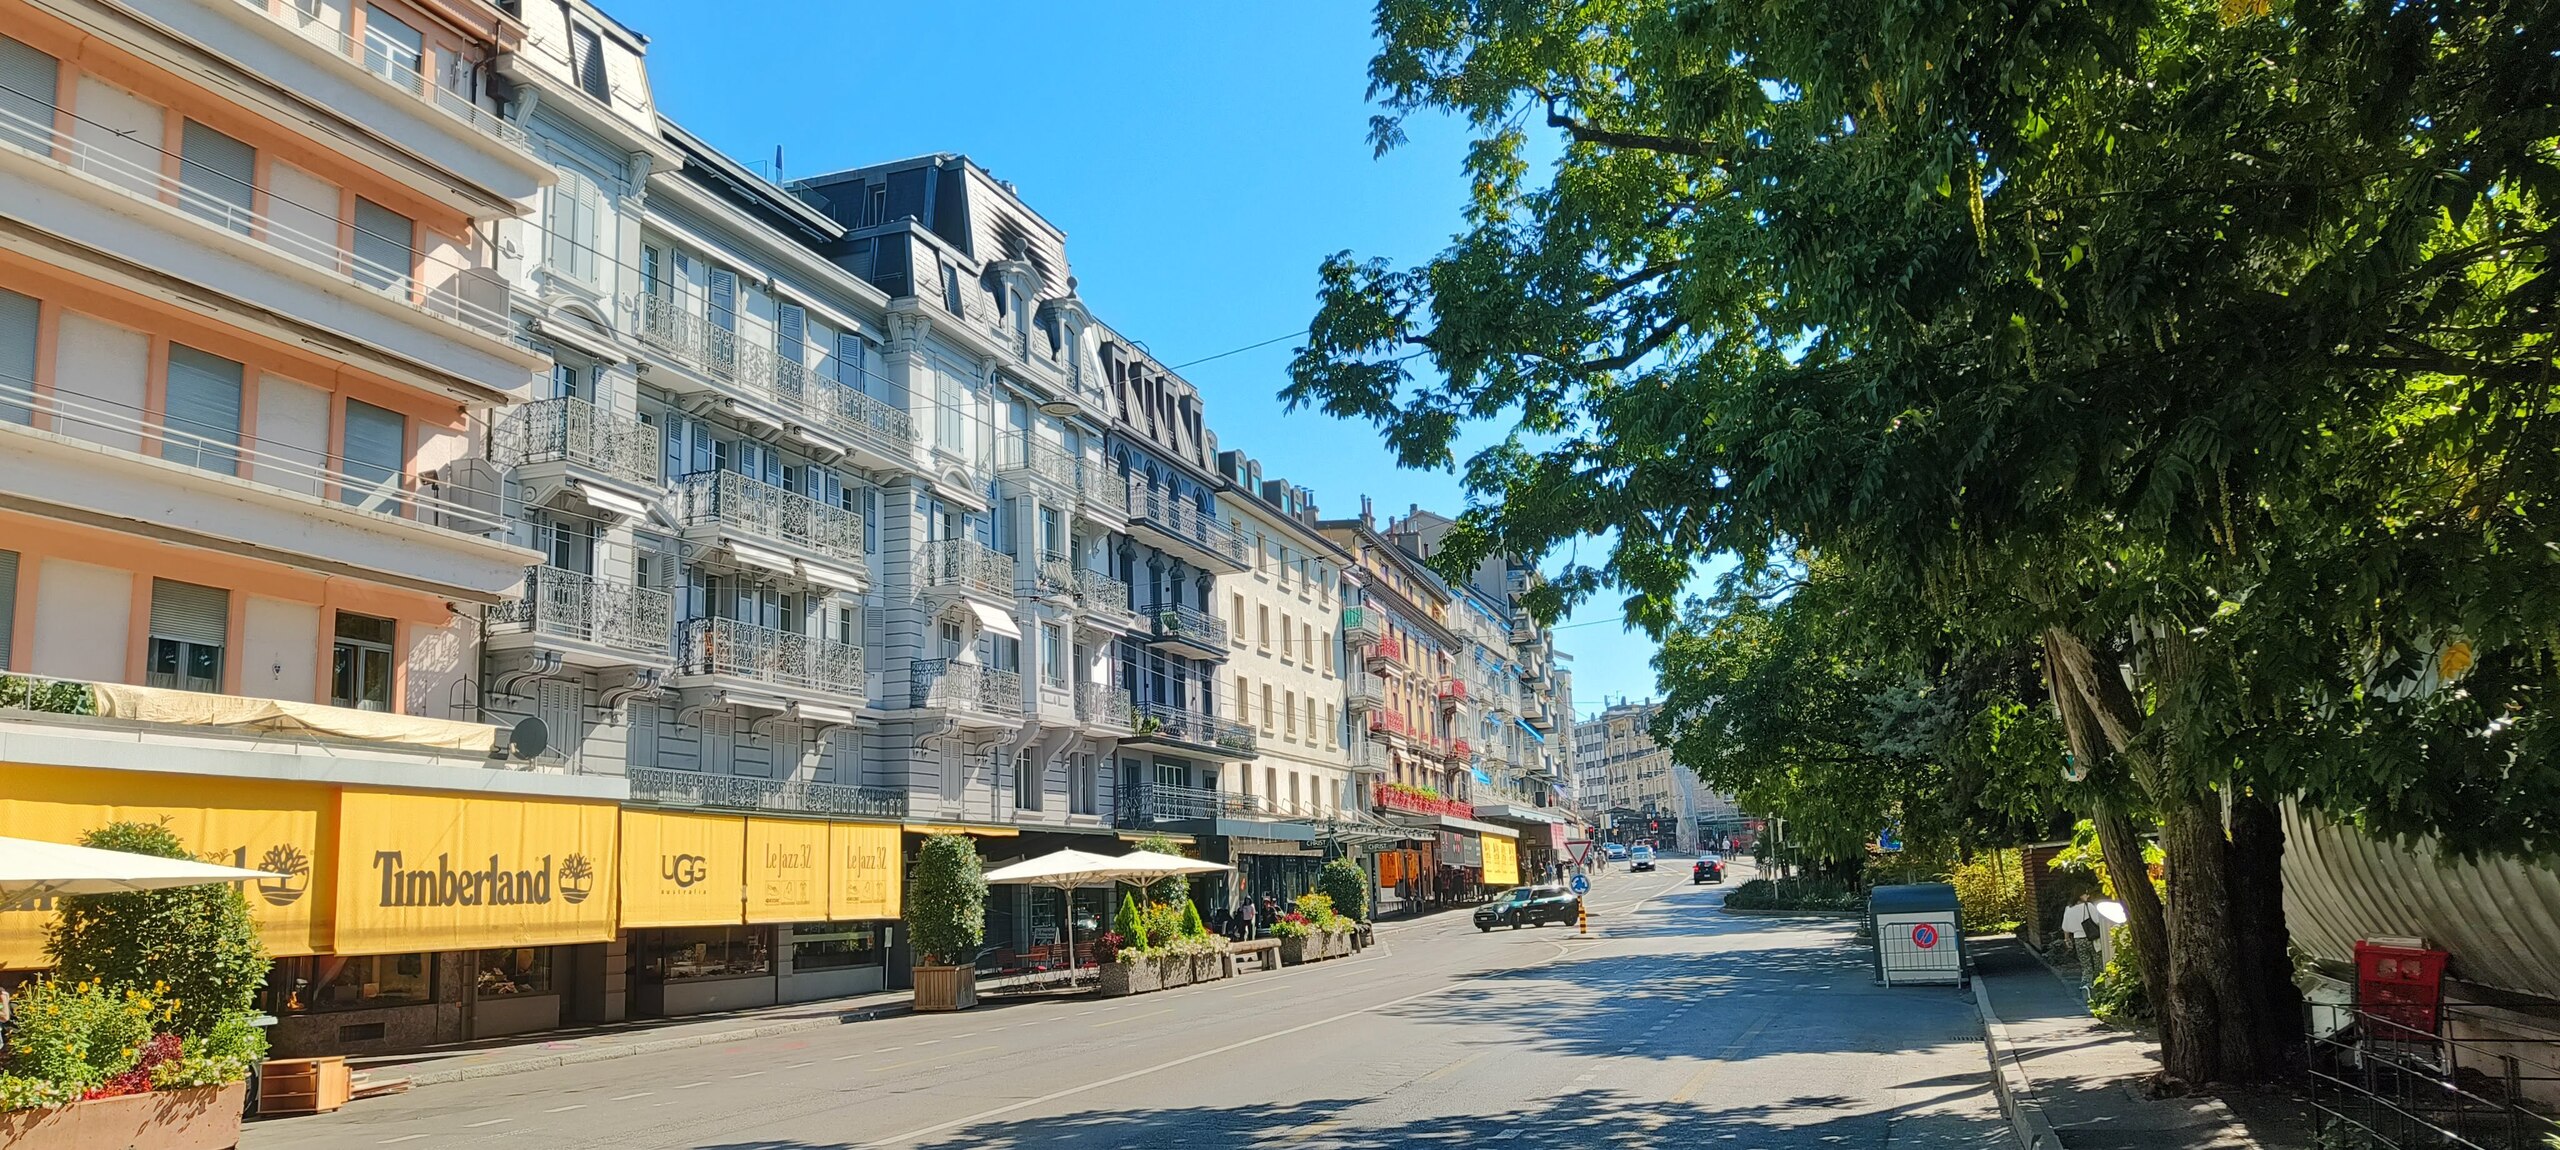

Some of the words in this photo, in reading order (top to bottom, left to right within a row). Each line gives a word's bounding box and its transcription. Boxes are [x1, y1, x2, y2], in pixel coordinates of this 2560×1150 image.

[661, 853, 707, 888] UGG
[766, 842, 777, 869] Le
[777, 843, 799, 878] Jazz
[800, 844, 811, 869] 32
[847, 845, 857, 869] Le
[857, 846, 876, 878] Jazz
[877, 846, 887, 869] 32
[373, 850, 551, 907] Timberland
